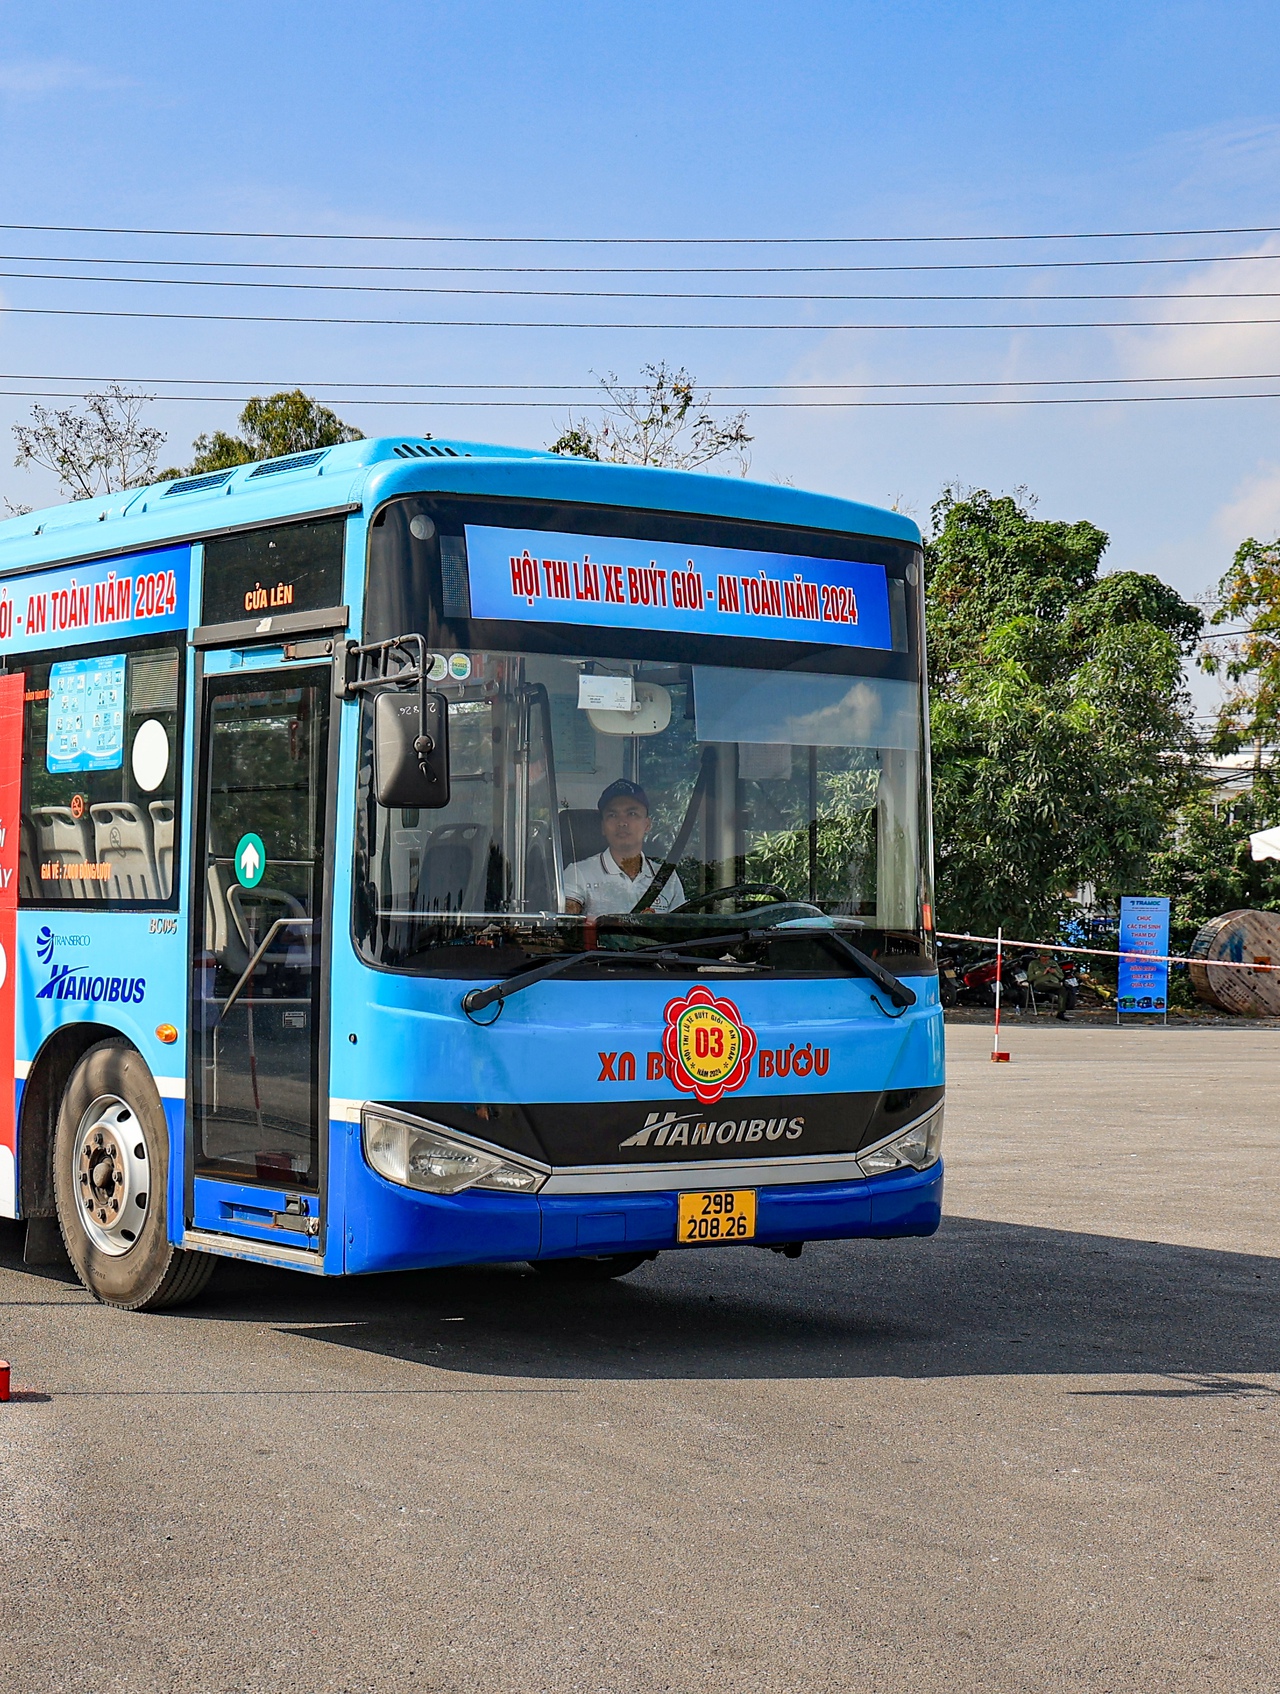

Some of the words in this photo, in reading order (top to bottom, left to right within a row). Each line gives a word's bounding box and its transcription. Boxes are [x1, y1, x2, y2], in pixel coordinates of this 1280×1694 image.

[25, 593, 47, 635] AN
[51, 579, 90, 631] TOÀN
[94, 572, 131, 624] NĂM
[134, 570, 176, 620] 2024
[245, 582, 267, 611] CỬA
[270, 581, 294, 607] LÊN
[510, 550, 541, 606] HỘI
[543, 560, 570, 600] THI
[571, 554, 600, 601] LÁI
[602, 564, 625, 605] XE
[627, 561, 668, 607] BUÝT
[671, 559, 705, 611] GIỎI
[717, 574, 740, 614] AN
[741, 570, 783, 619] TOÀN
[784, 573, 819, 622] NĂM
[821, 586, 858, 625] 2024
[54, 934, 91, 946] TRANSERCO
[36, 965, 146, 1004] HANOIBUS
[695, 1026, 724, 1058] 03
[619, 1112, 805, 1148] HANOIBUS
[701, 1193, 734, 1215] 29B
[687, 1216, 747, 1239] 208.26
